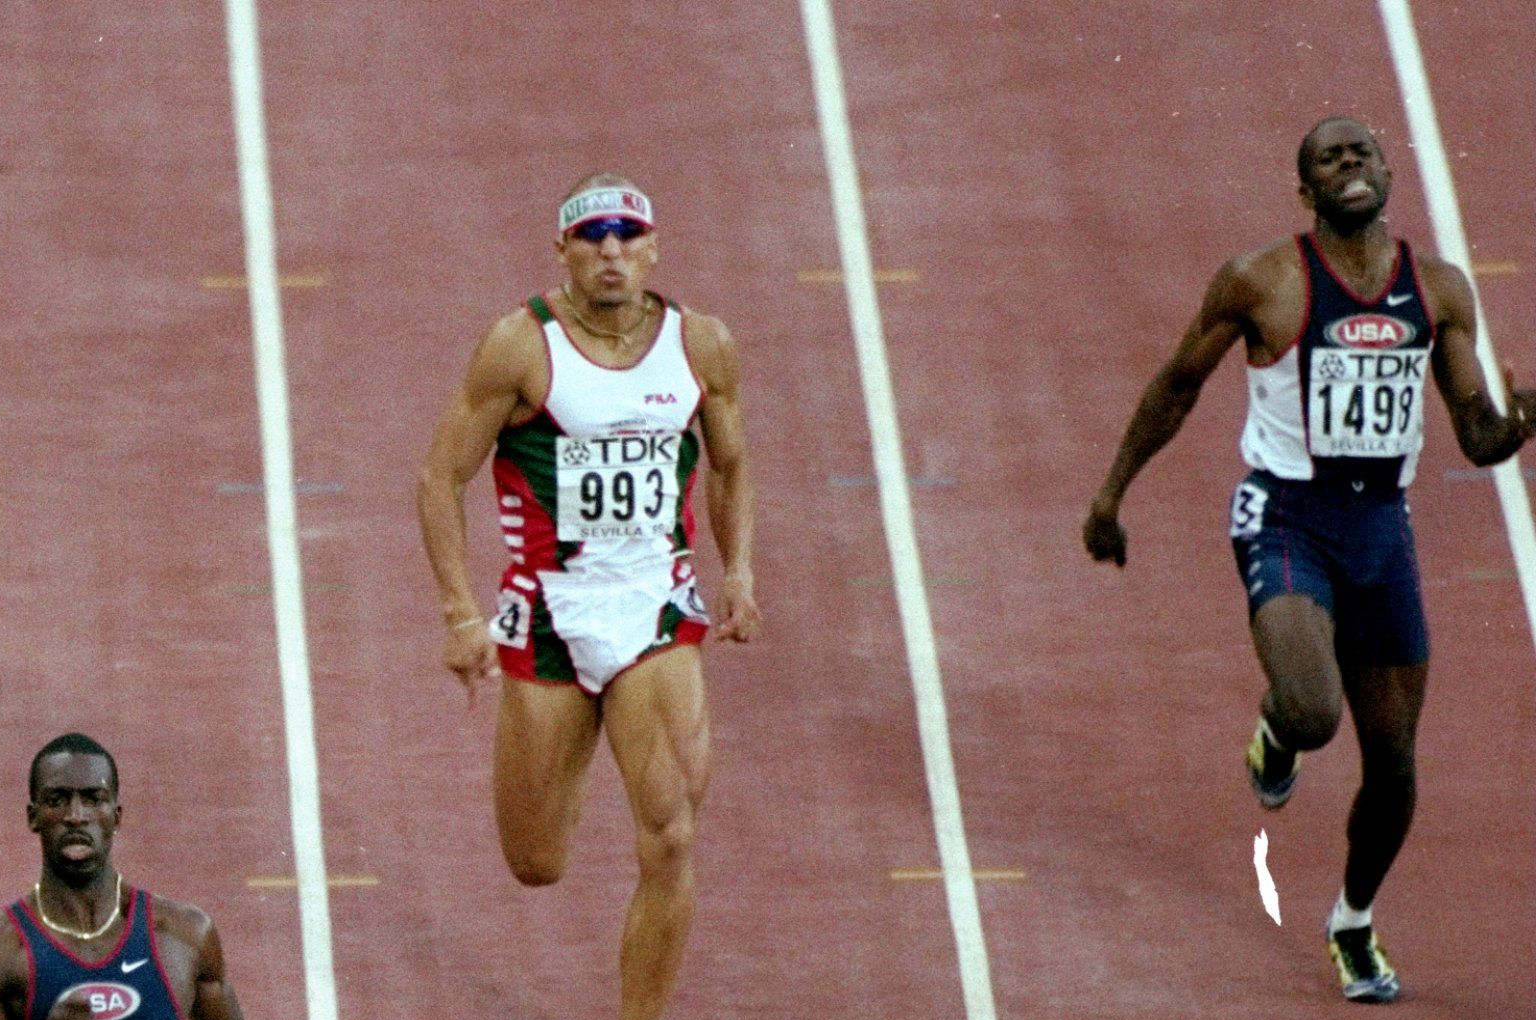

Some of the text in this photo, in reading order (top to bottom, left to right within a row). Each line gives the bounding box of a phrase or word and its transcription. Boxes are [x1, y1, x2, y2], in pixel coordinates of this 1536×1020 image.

[1343, 323, 1398, 342] USA
[1348, 355, 1424, 379] TDK
[591, 435, 675, 464] TDK
[580, 468, 665, 521] 993
[1236, 489, 1255, 529] 3
[580, 526, 643, 538] SEVILLA
[498, 602, 520, 639] 4
[89, 993, 127, 1013] SA
